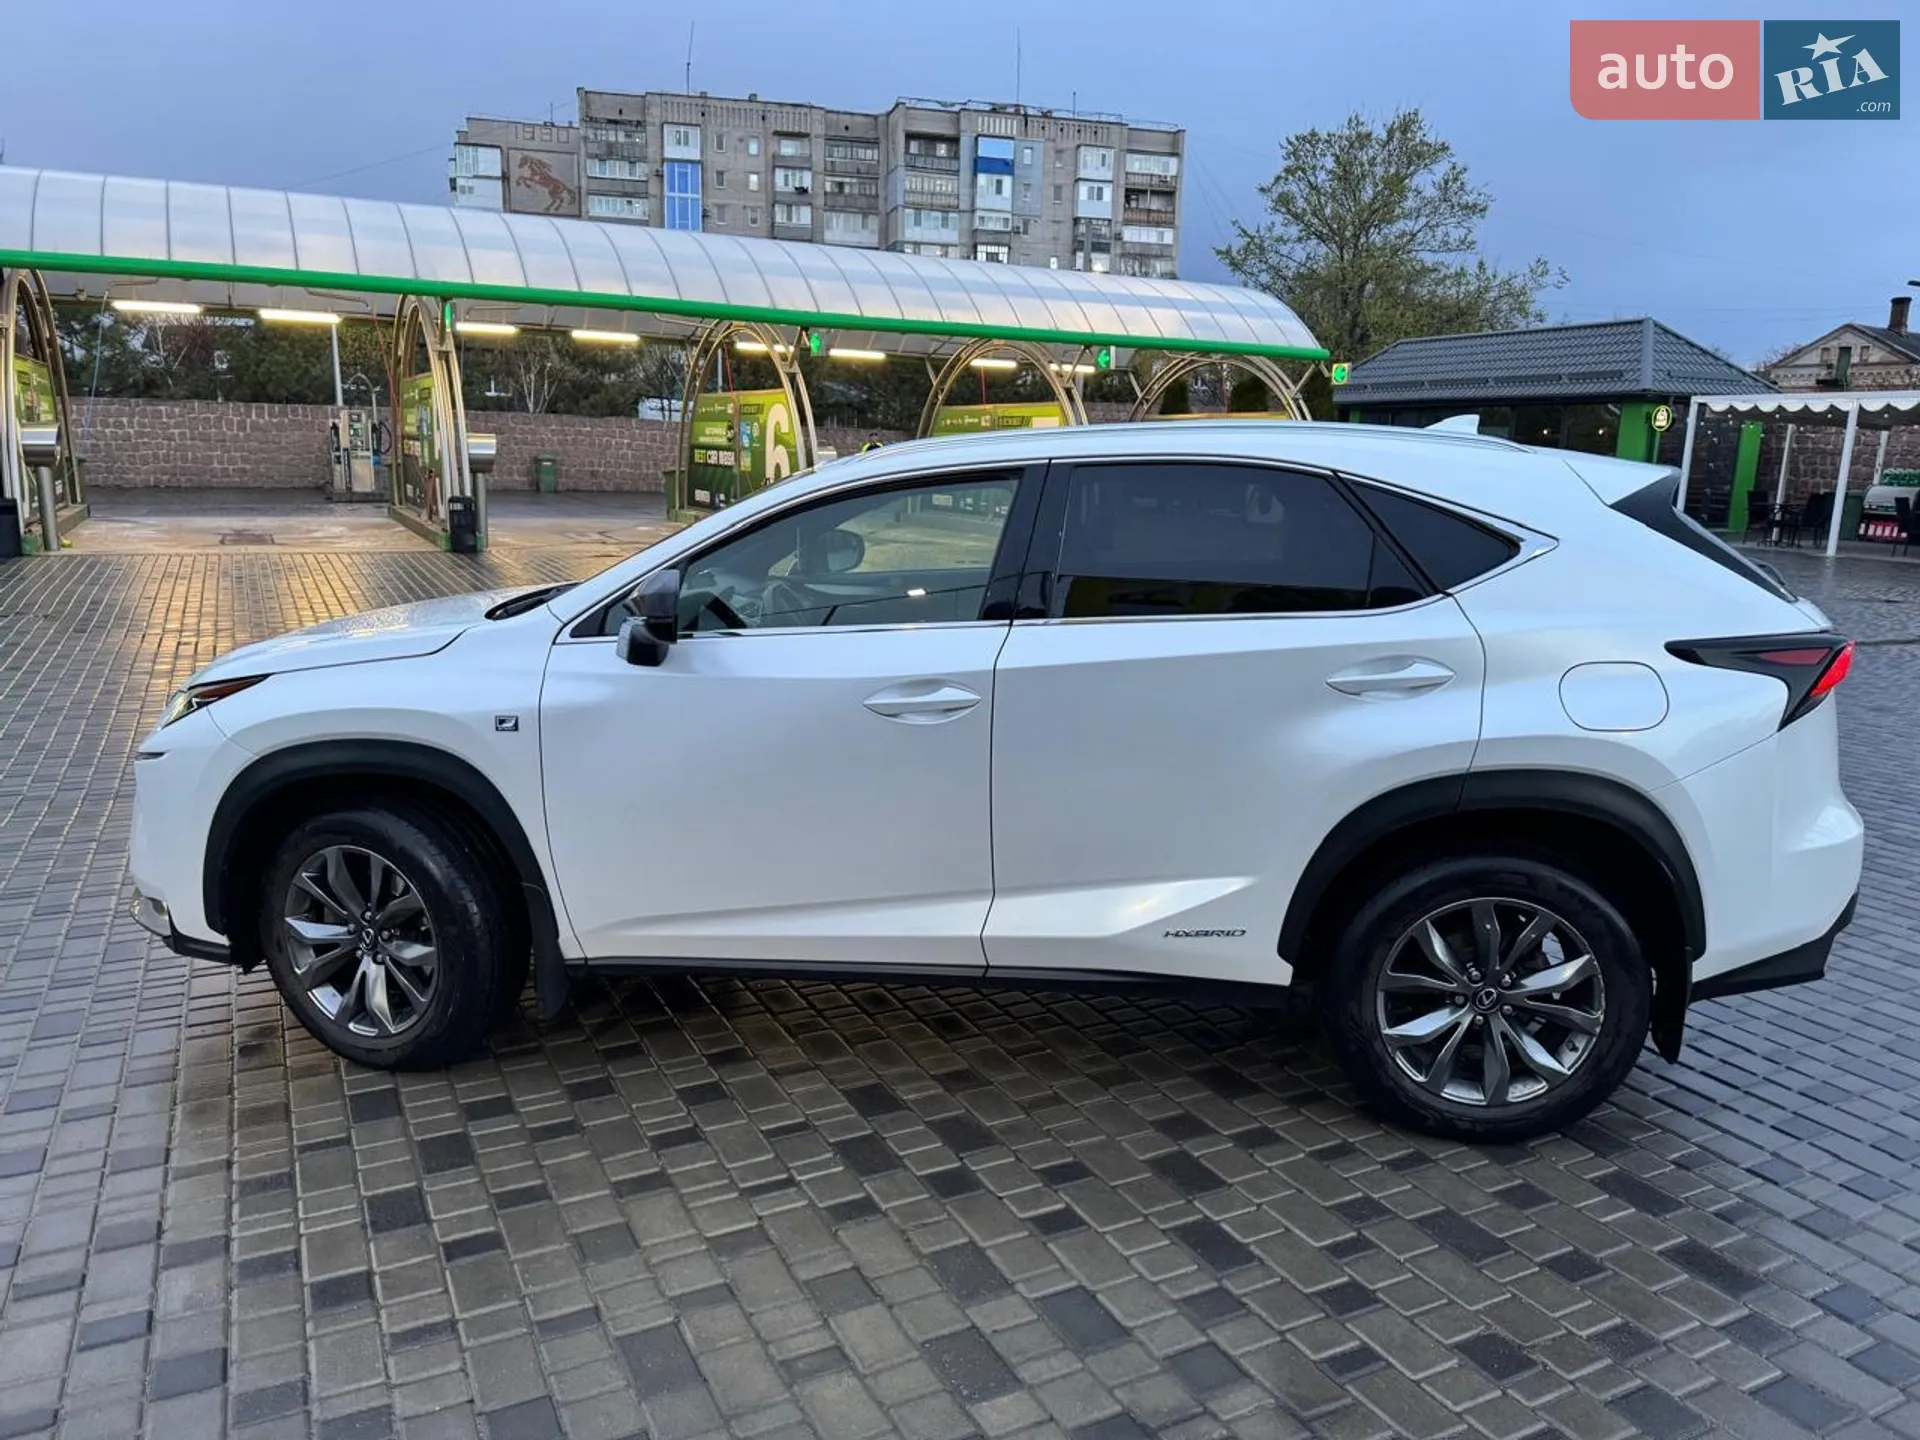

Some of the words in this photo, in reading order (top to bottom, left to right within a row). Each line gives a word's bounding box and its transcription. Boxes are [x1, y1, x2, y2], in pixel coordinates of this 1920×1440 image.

[515, 125, 570, 144] 1990
[765, 403, 791, 483] 6
[706, 450, 718, 465] CAR
[1163, 929, 1248, 938] HYBRID
